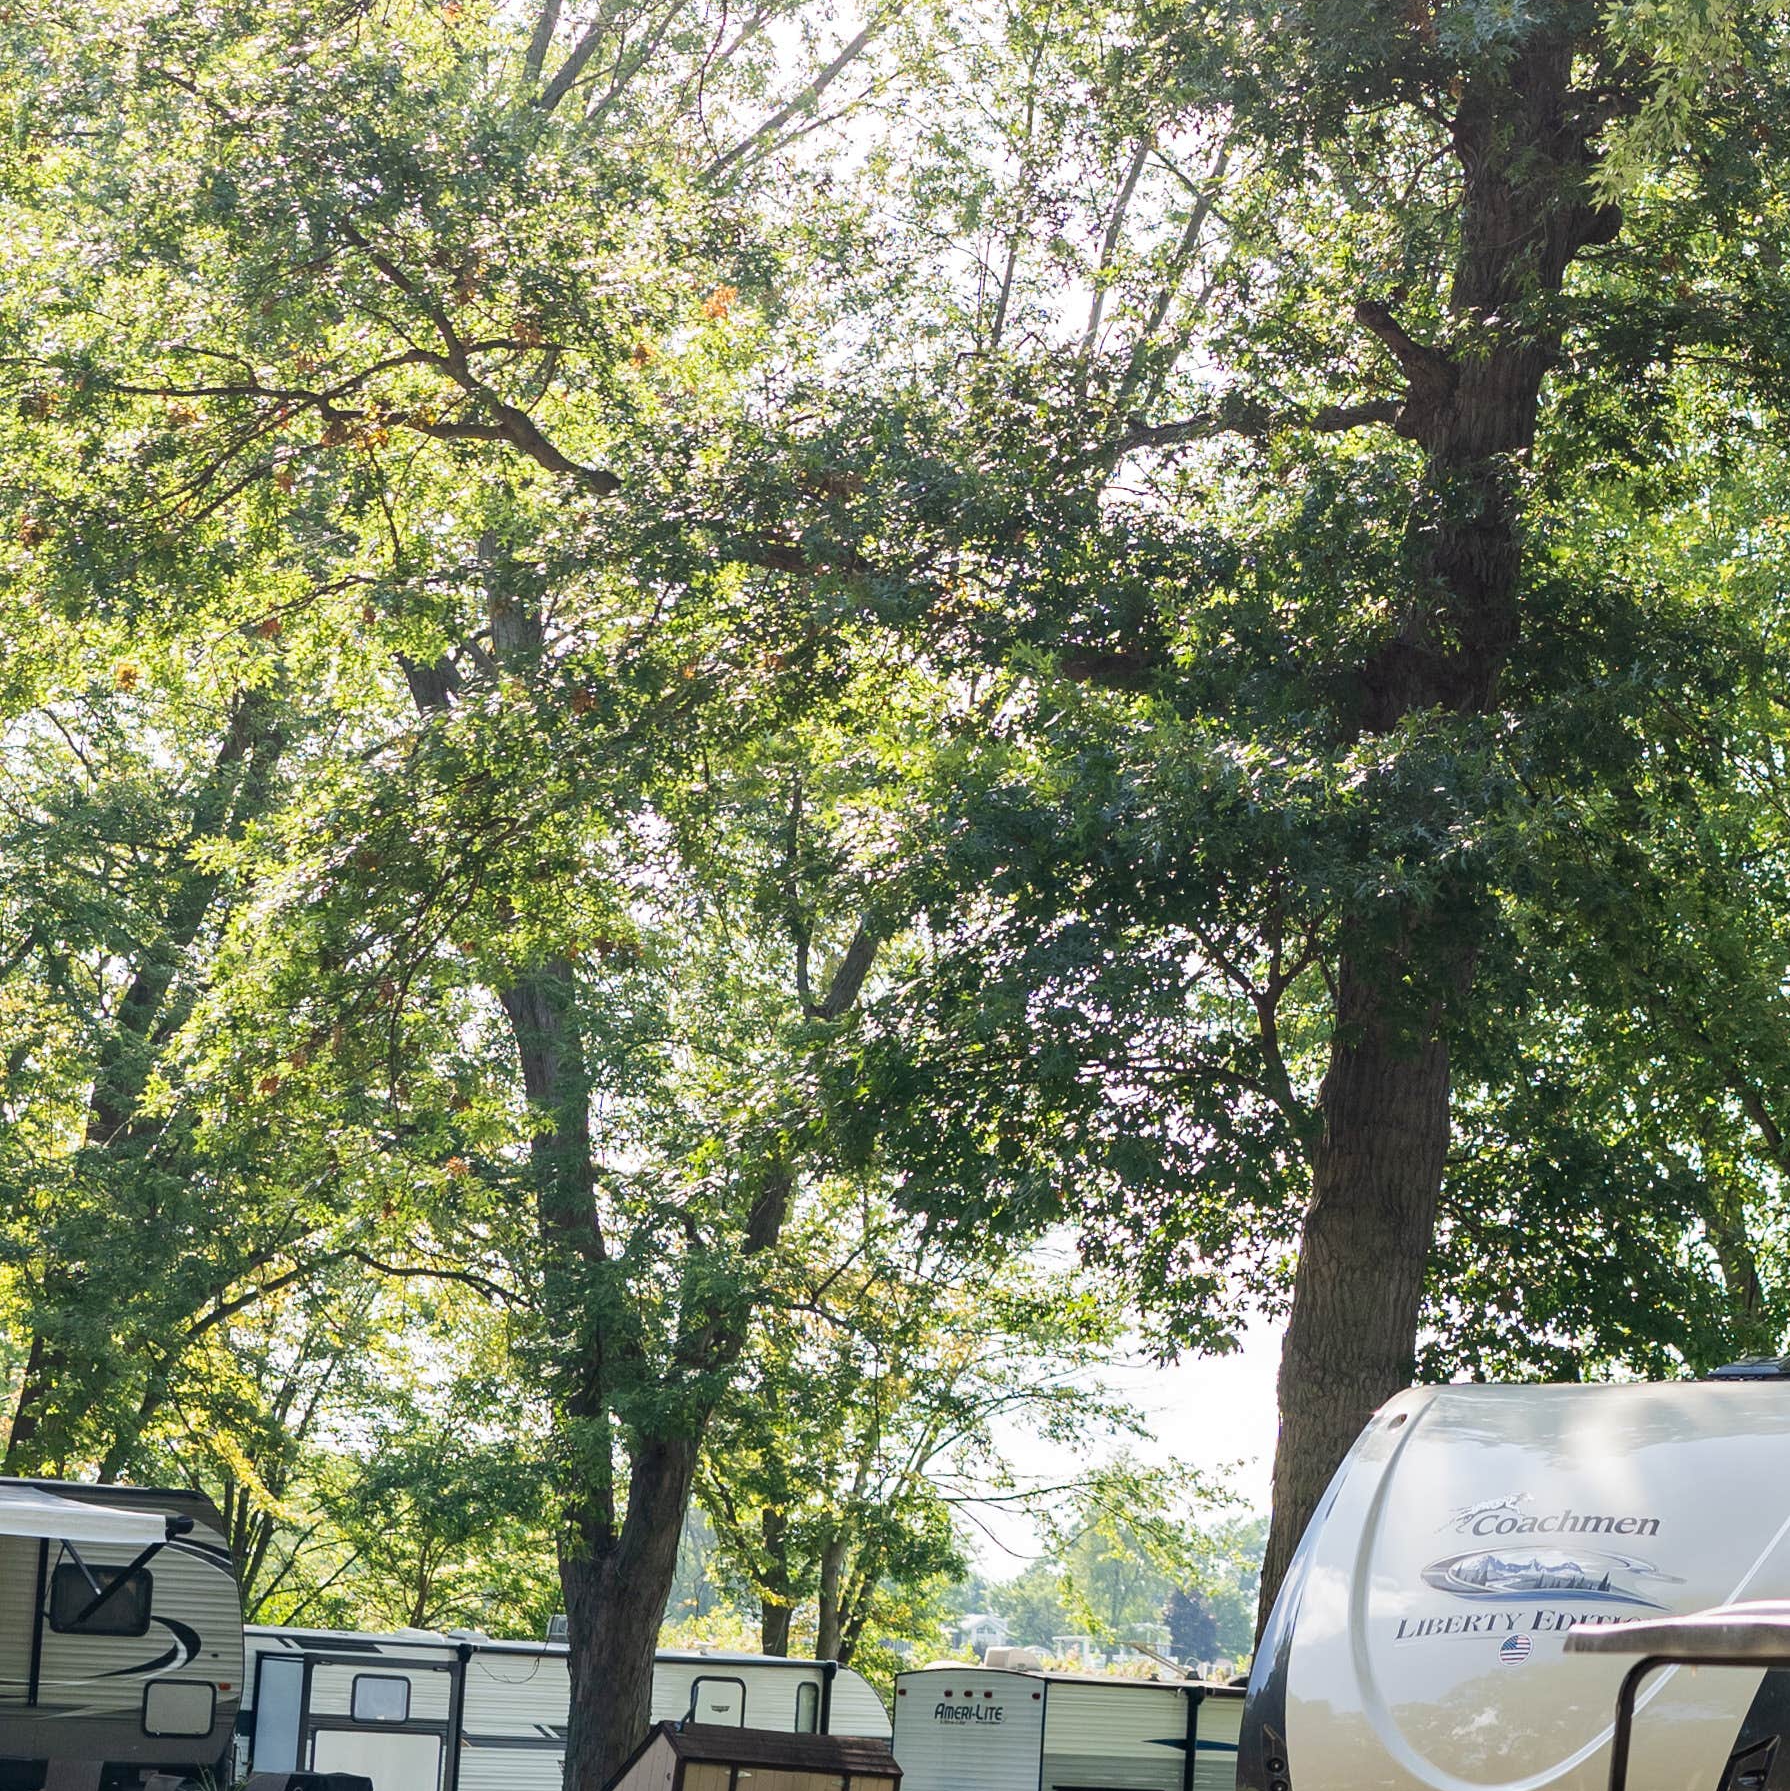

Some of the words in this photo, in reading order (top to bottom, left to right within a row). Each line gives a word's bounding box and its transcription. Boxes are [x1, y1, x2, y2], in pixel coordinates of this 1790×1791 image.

[1472, 1510, 1660, 1537] Coachmen
[1394, 1611, 1523, 1641] LIBERTY
[934, 1703, 1004, 1721] AMERI-LITE
